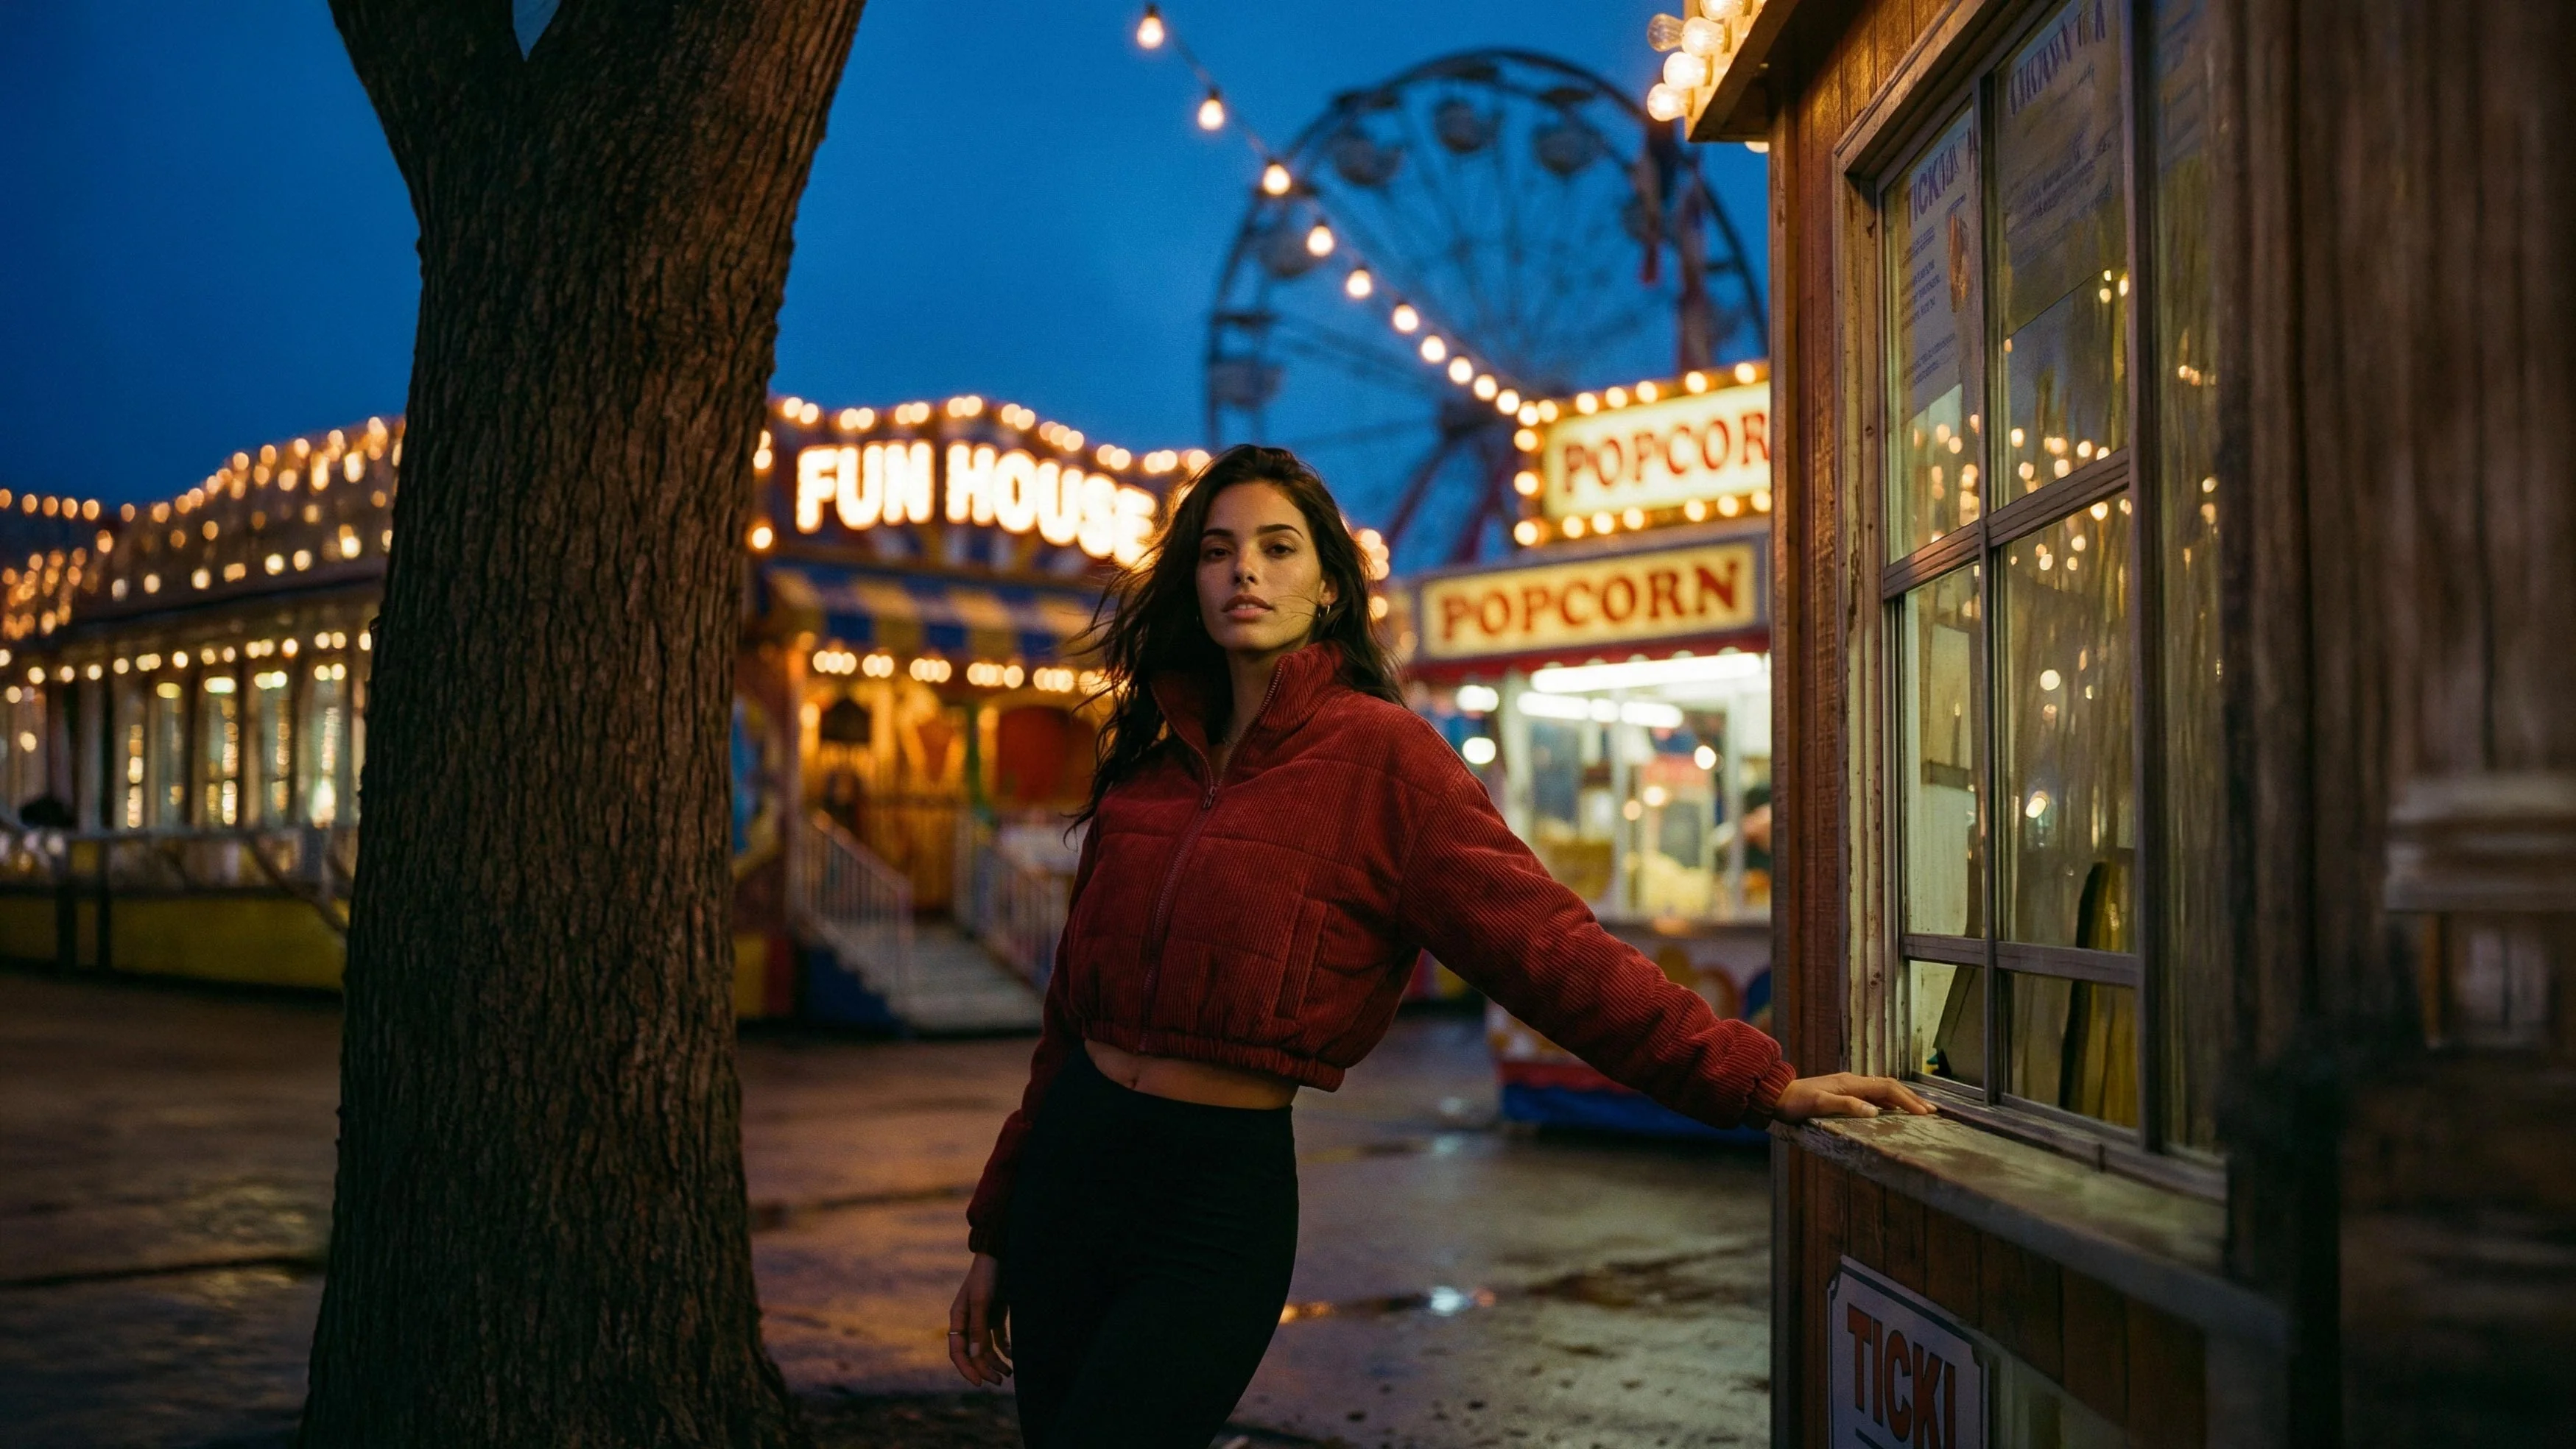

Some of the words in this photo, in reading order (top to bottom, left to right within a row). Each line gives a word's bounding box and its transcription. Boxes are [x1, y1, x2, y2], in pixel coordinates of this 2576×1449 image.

[796, 442, 934, 534] FUN
[946, 443, 1158, 571] HOUSE
[1440, 559, 1739, 641] POPCORN
